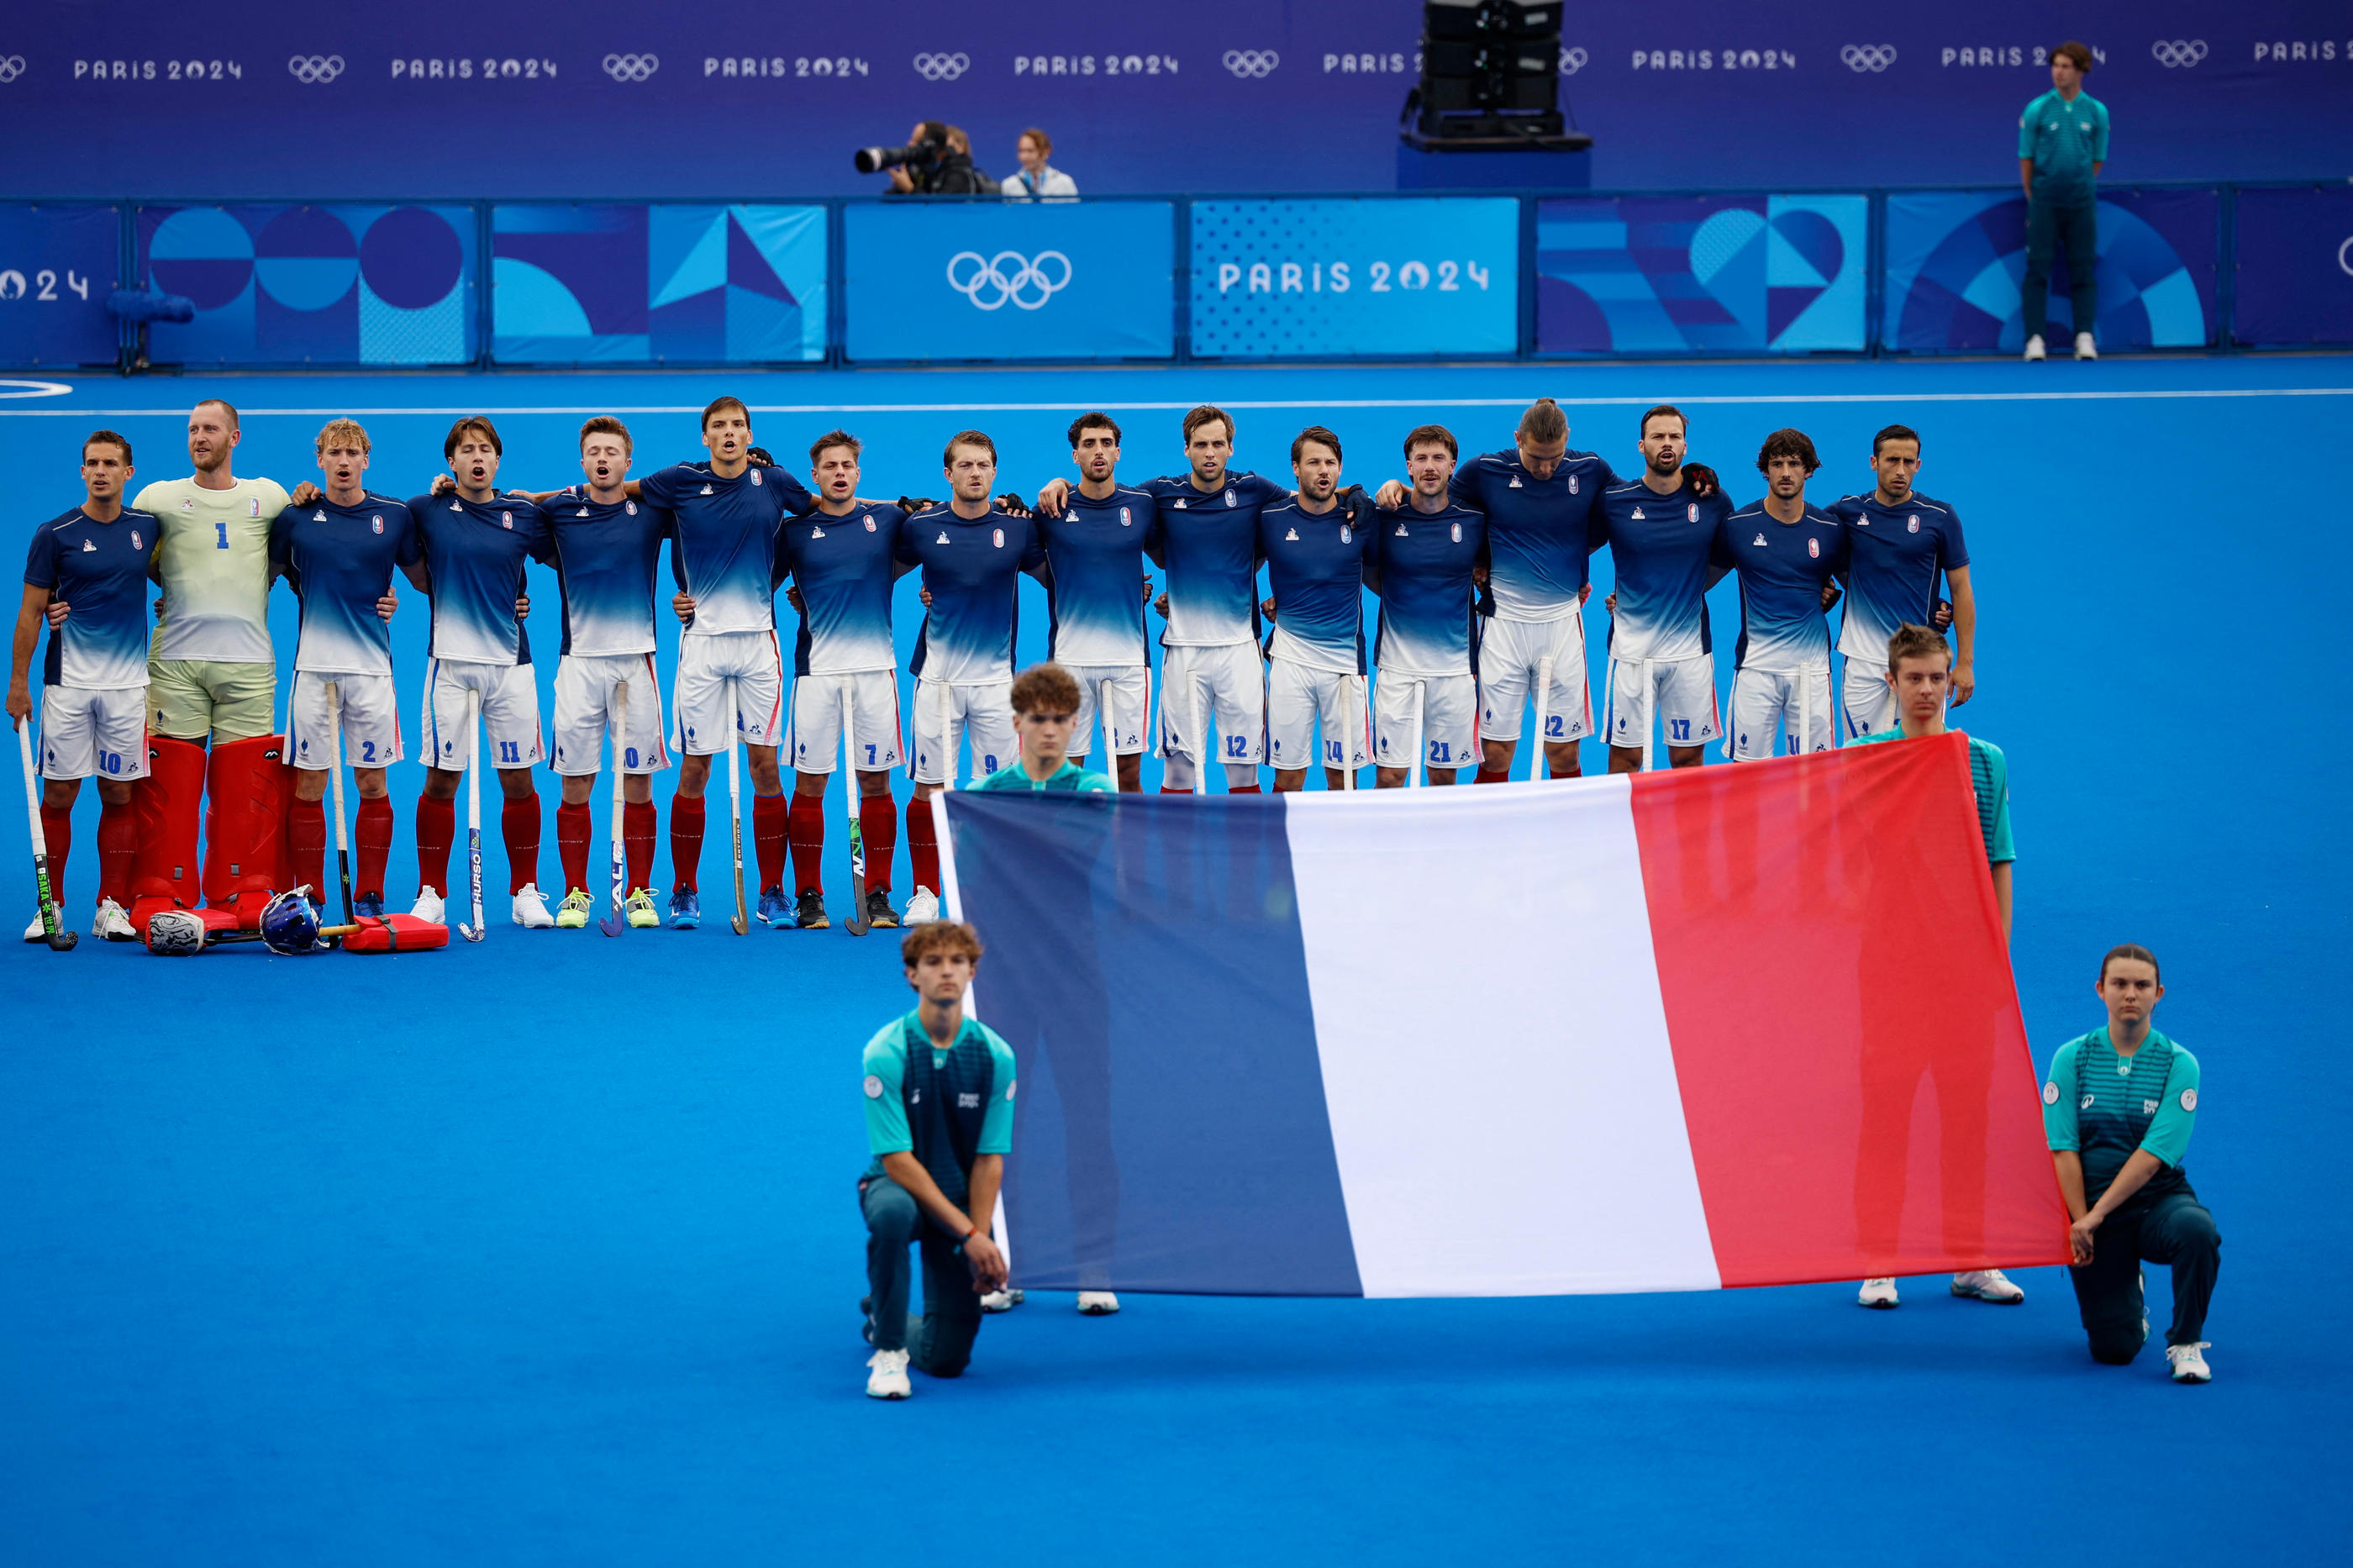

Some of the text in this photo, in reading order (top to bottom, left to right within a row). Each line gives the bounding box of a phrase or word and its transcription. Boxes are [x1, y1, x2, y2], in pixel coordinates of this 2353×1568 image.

[168, 59, 242, 79] 2024
[483, 58, 557, 78] 2024
[795, 56, 869, 76] 2024
[1105, 55, 1178, 74] 2024
[1723, 49, 1796, 69] 2024
[1370, 260, 1489, 292] 2024
[215, 522, 229, 549] 1
[1671, 718, 1691, 740] 17
[362, 740, 376, 762] 2
[499, 741, 520, 763] 11
[865, 744, 876, 766] 7
[1226, 735, 1247, 757] 12
[1325, 739, 1343, 763] 14
[1430, 739, 1451, 762] 21
[99, 750, 121, 774] 10
[984, 754, 998, 775] 9
